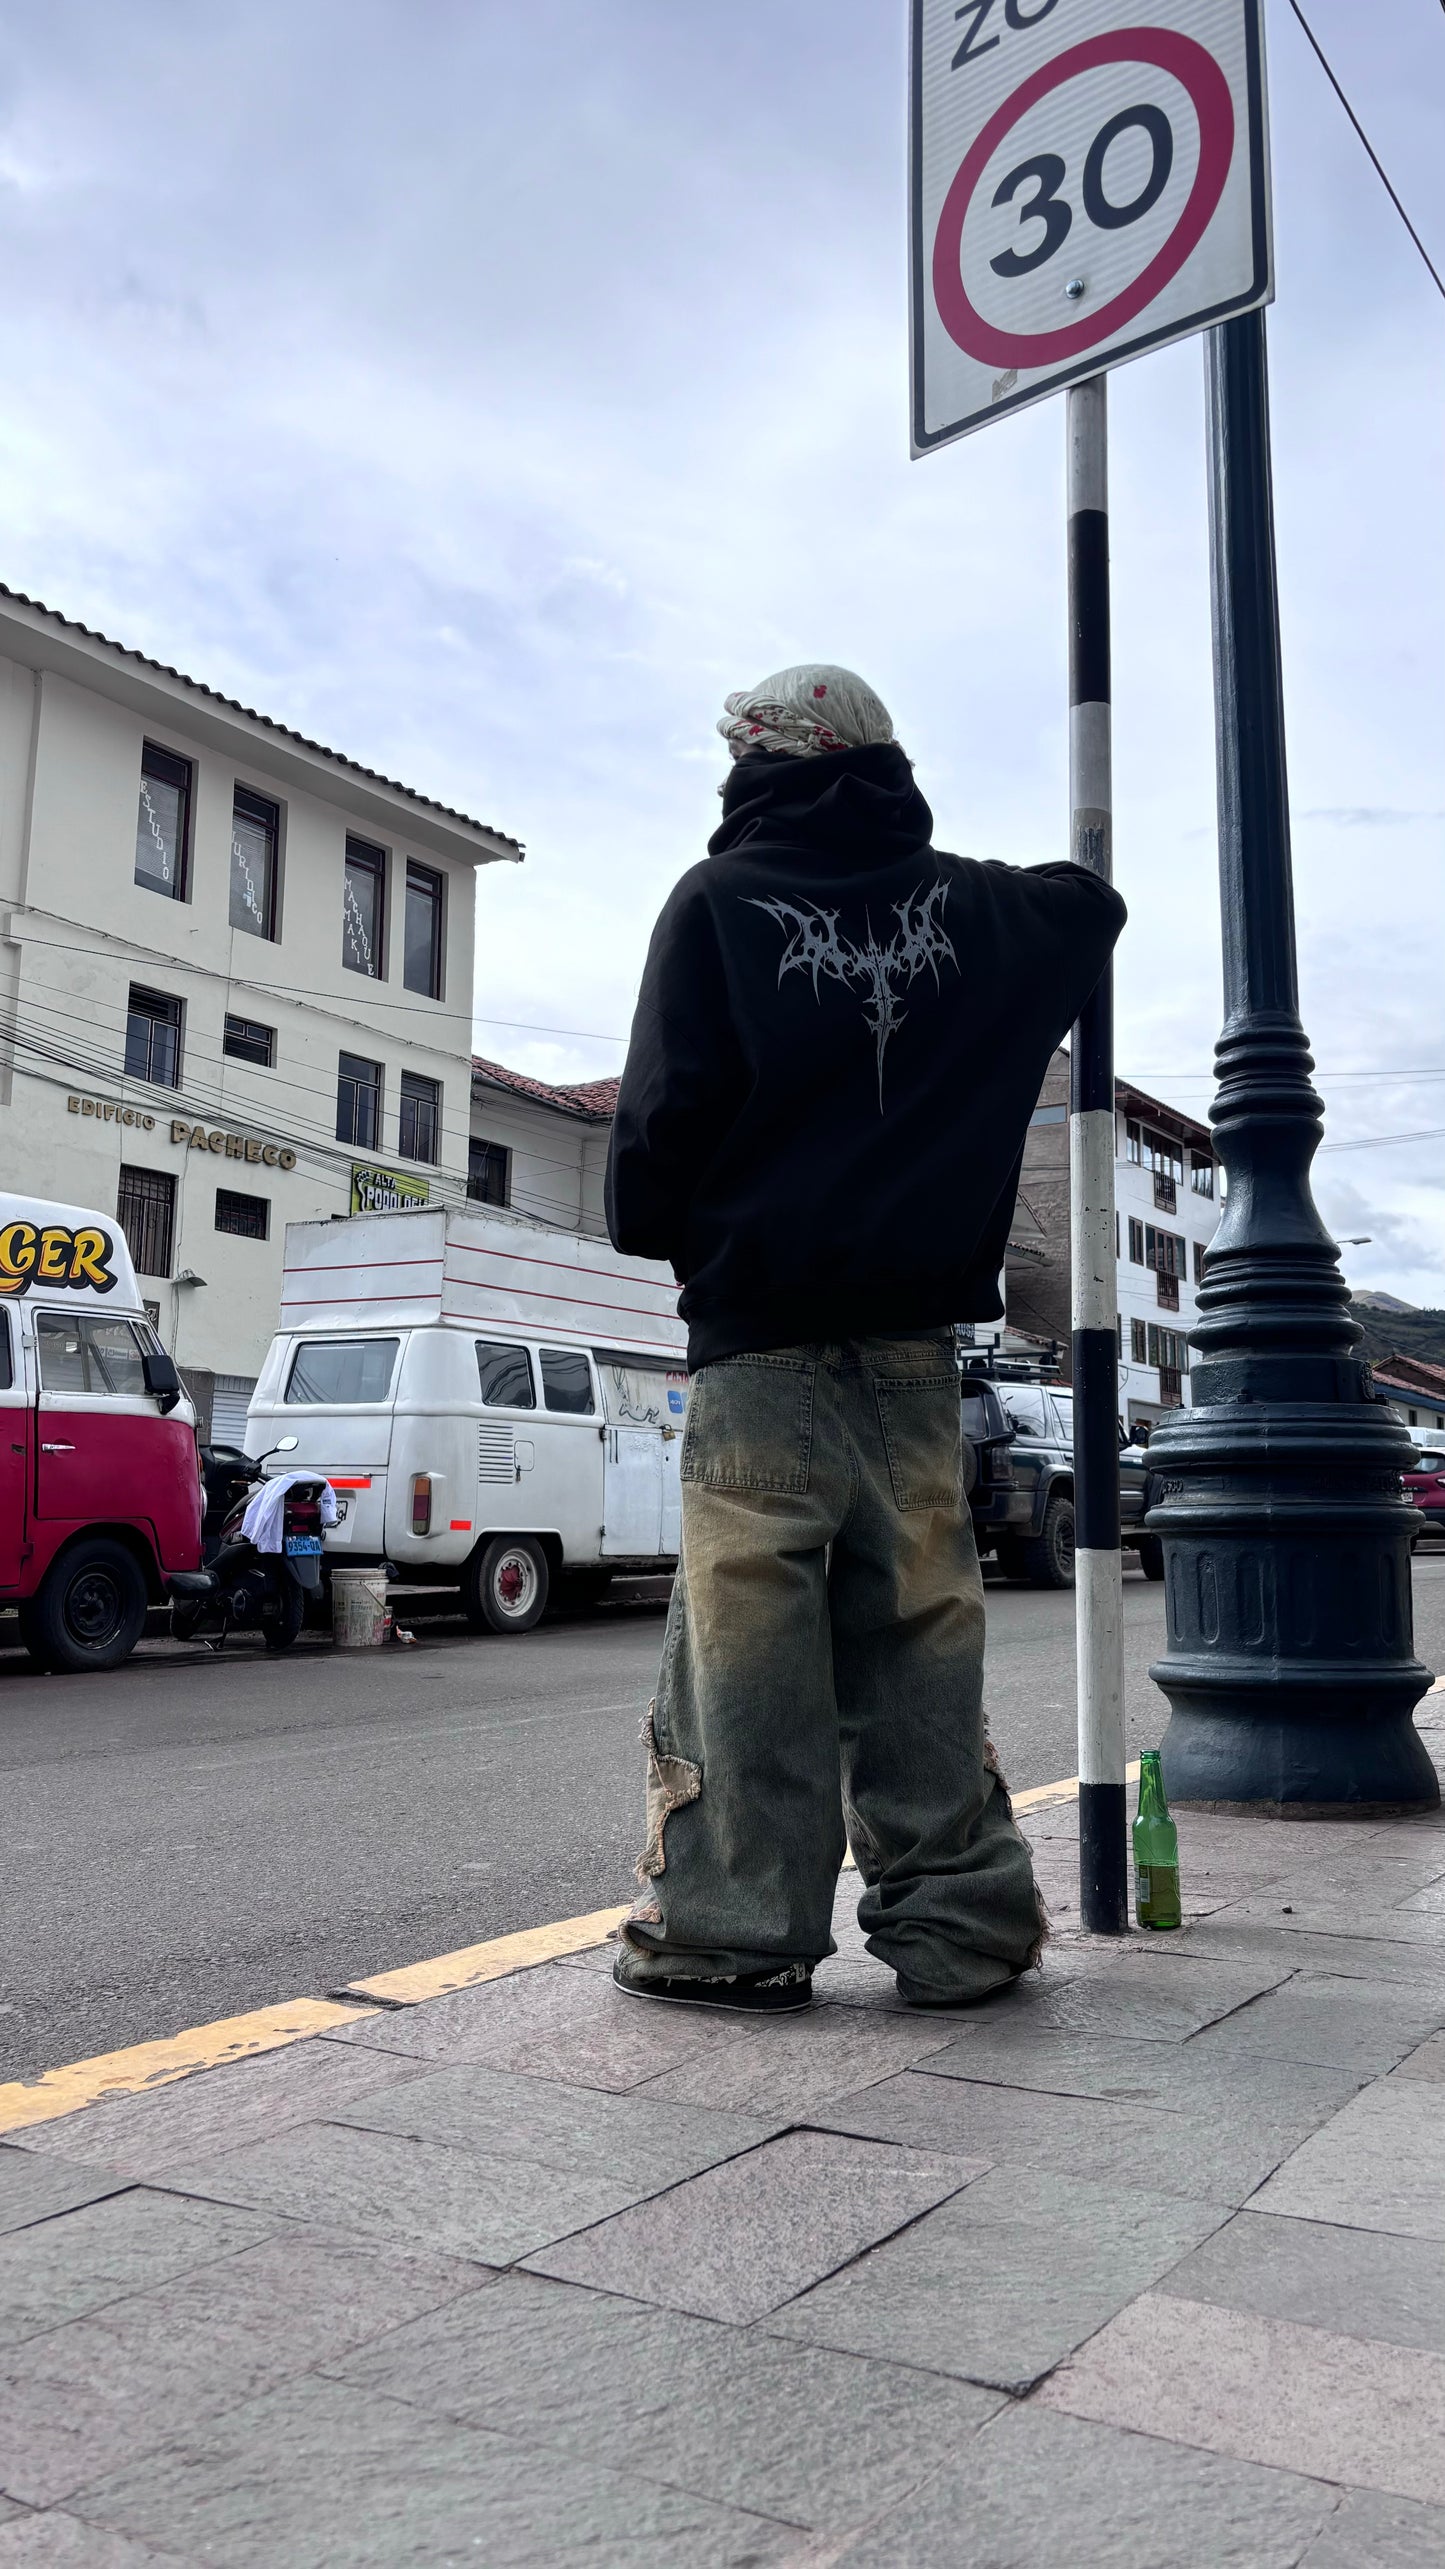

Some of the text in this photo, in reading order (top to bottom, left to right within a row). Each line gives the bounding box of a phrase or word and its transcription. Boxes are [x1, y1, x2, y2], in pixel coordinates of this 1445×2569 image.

[989, 103, 1174, 278] 30
[140, 780, 169, 880] ESTUDIO
[68, 1095, 297, 1170] EDIFICIO PACHECO
[375, 1173, 397, 1189] ALTA
